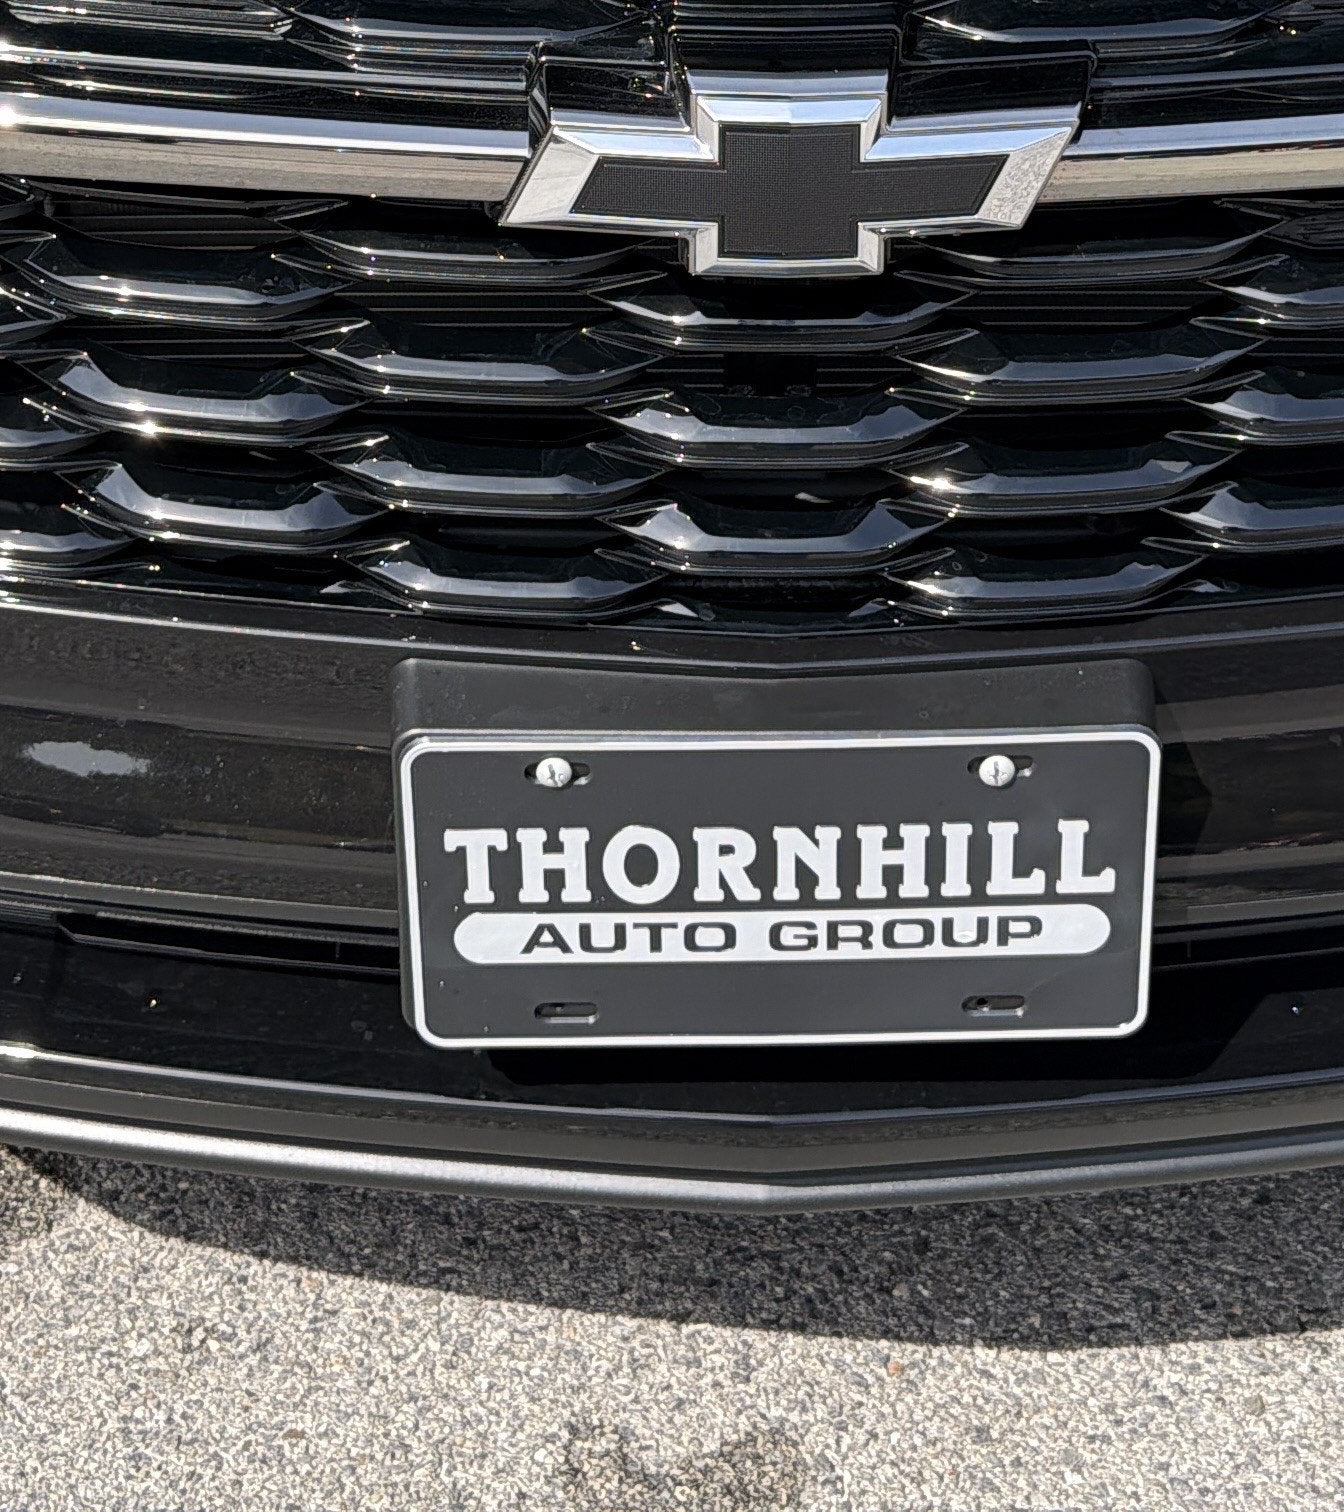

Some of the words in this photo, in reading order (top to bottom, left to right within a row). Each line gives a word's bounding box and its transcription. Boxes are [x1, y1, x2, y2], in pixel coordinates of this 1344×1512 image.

[444, 819, 1116, 905] THORNHILL
[520, 920, 737, 955] AUTO
[768, 915, 1044, 953] GROUP
